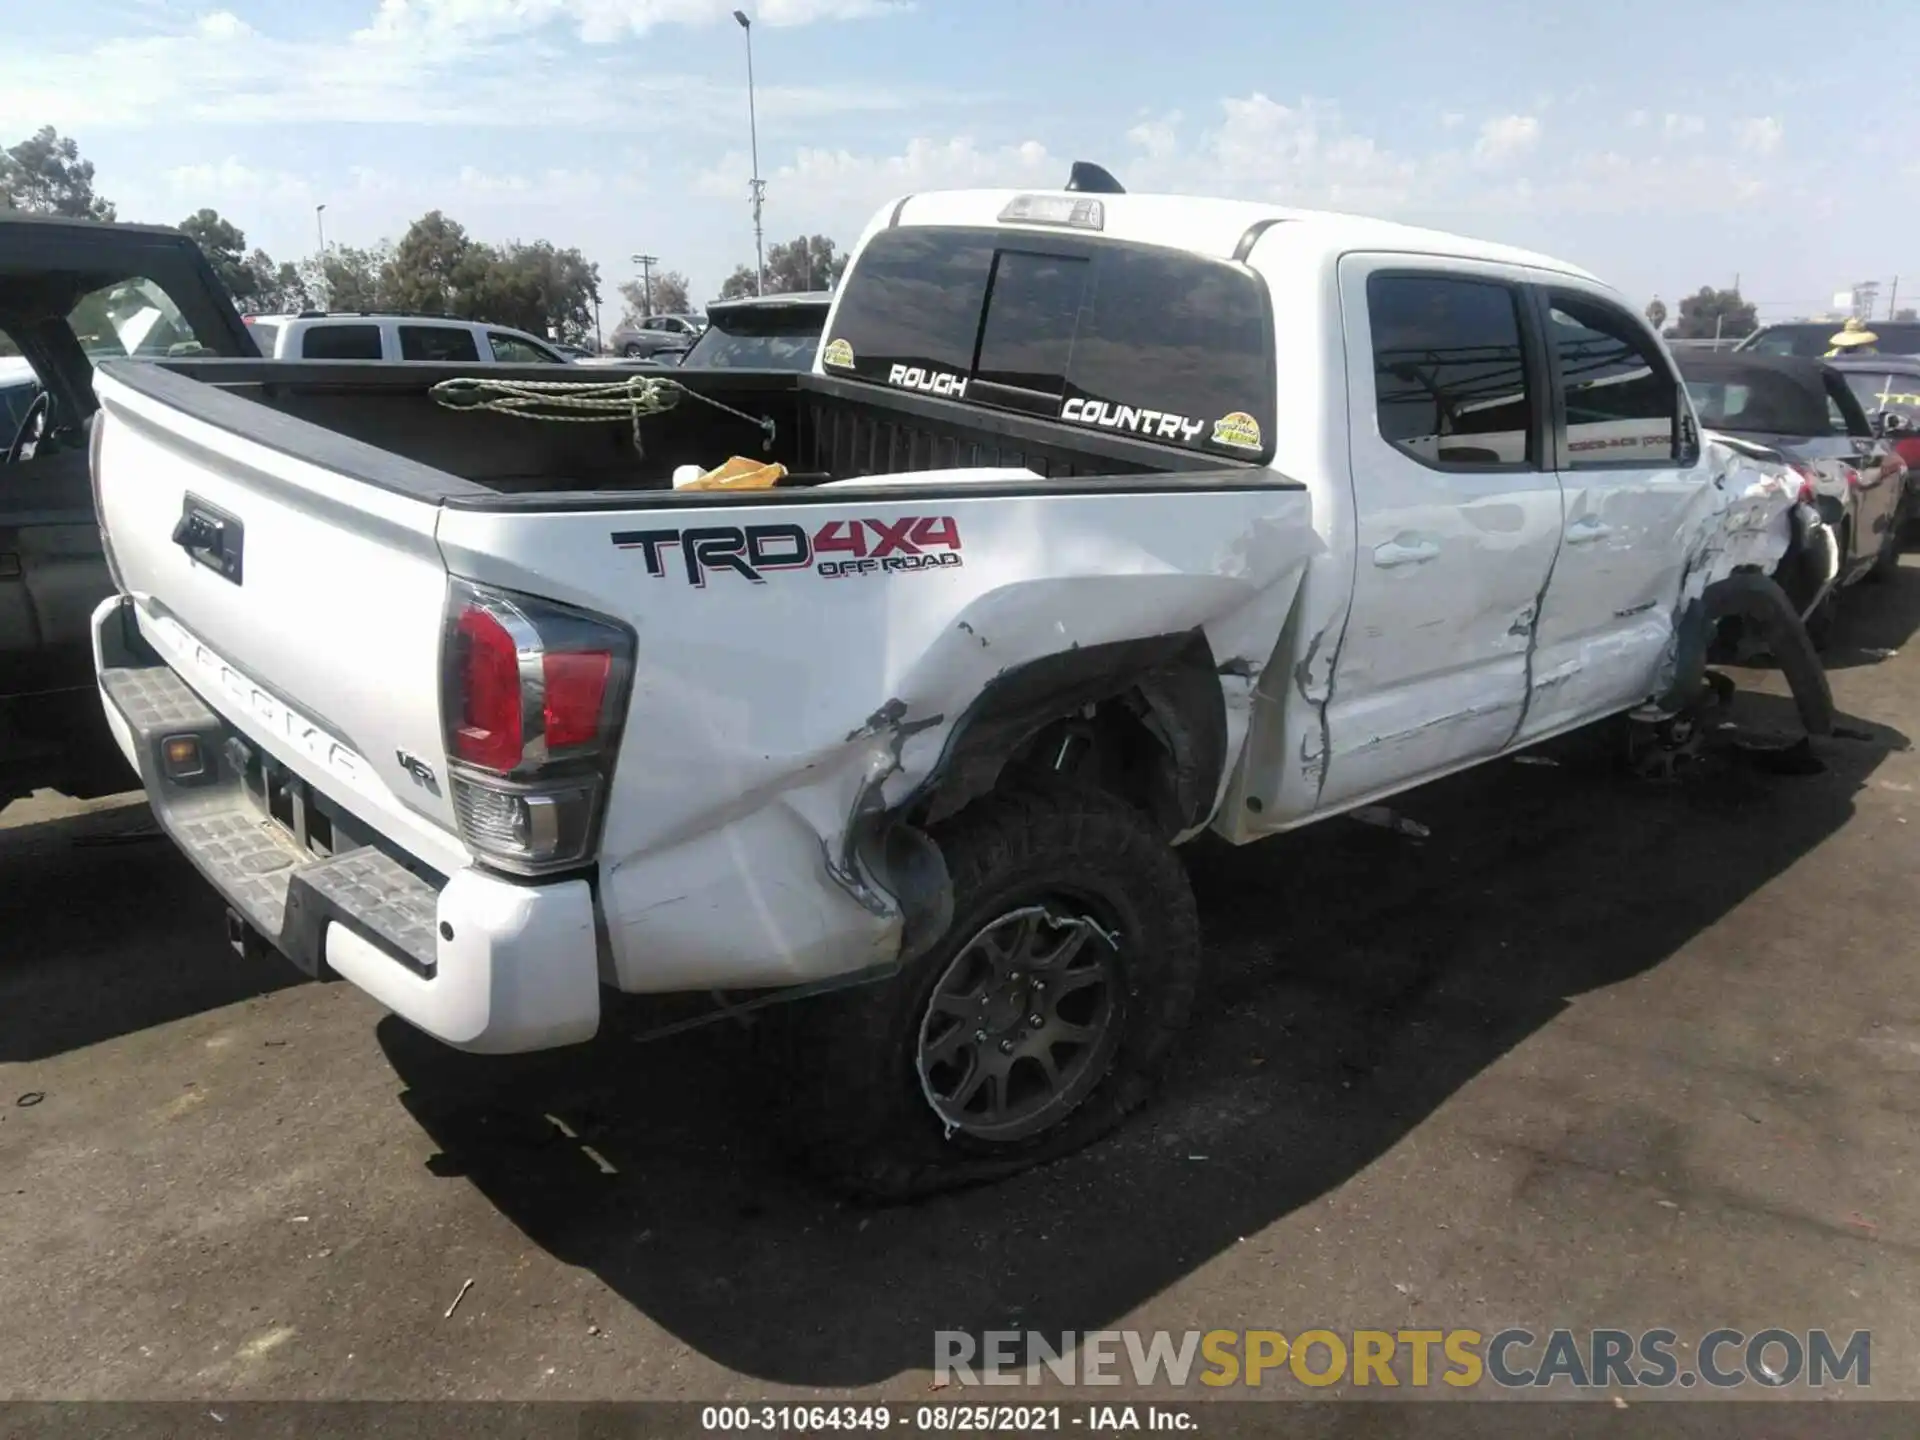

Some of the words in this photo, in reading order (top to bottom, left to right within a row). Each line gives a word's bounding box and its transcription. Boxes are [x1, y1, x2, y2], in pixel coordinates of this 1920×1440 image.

[889, 363, 968, 398] ROUGH
[1061, 397, 1204, 442] COUNTRY
[610, 524, 814, 589] TRD
[813, 516, 962, 558] 4X4
[817, 558, 880, 579] OFF
[881, 552, 963, 573] ROAD
